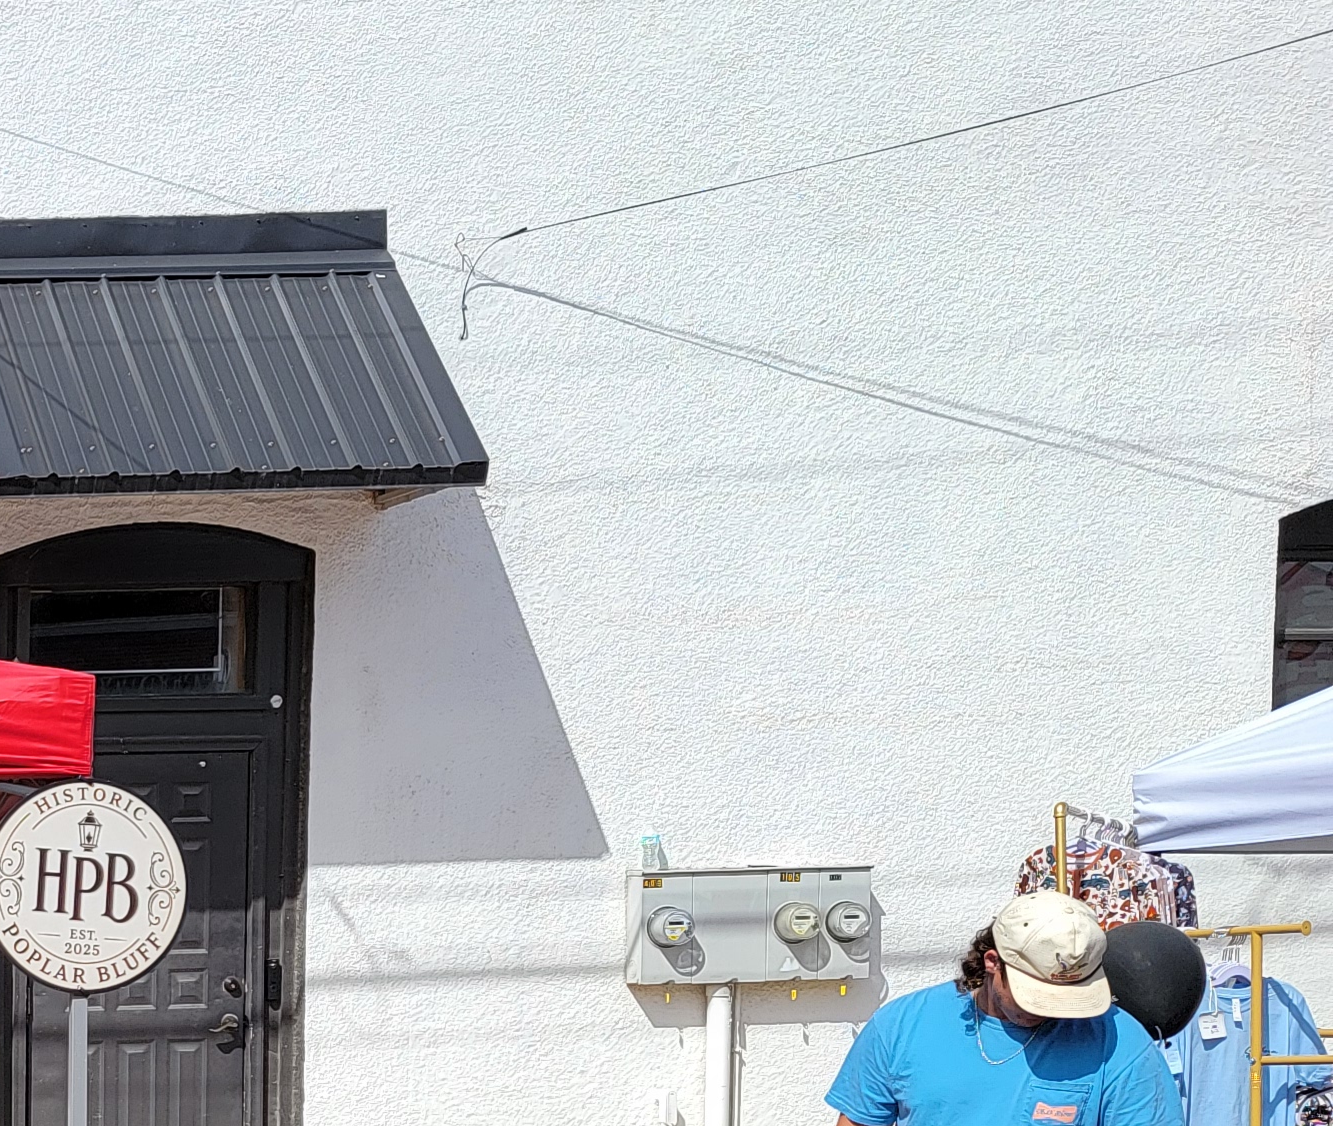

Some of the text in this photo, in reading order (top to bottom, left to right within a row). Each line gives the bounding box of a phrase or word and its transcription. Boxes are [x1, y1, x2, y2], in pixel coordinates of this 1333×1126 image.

[32, 787, 147, 822] HISTORIC
[31, 847, 139, 924] HPB
[64, 942, 100, 956] 2025
[69, 928, 98, 942] EST.
[1, 922, 163, 984] POPLAR BLUFF
